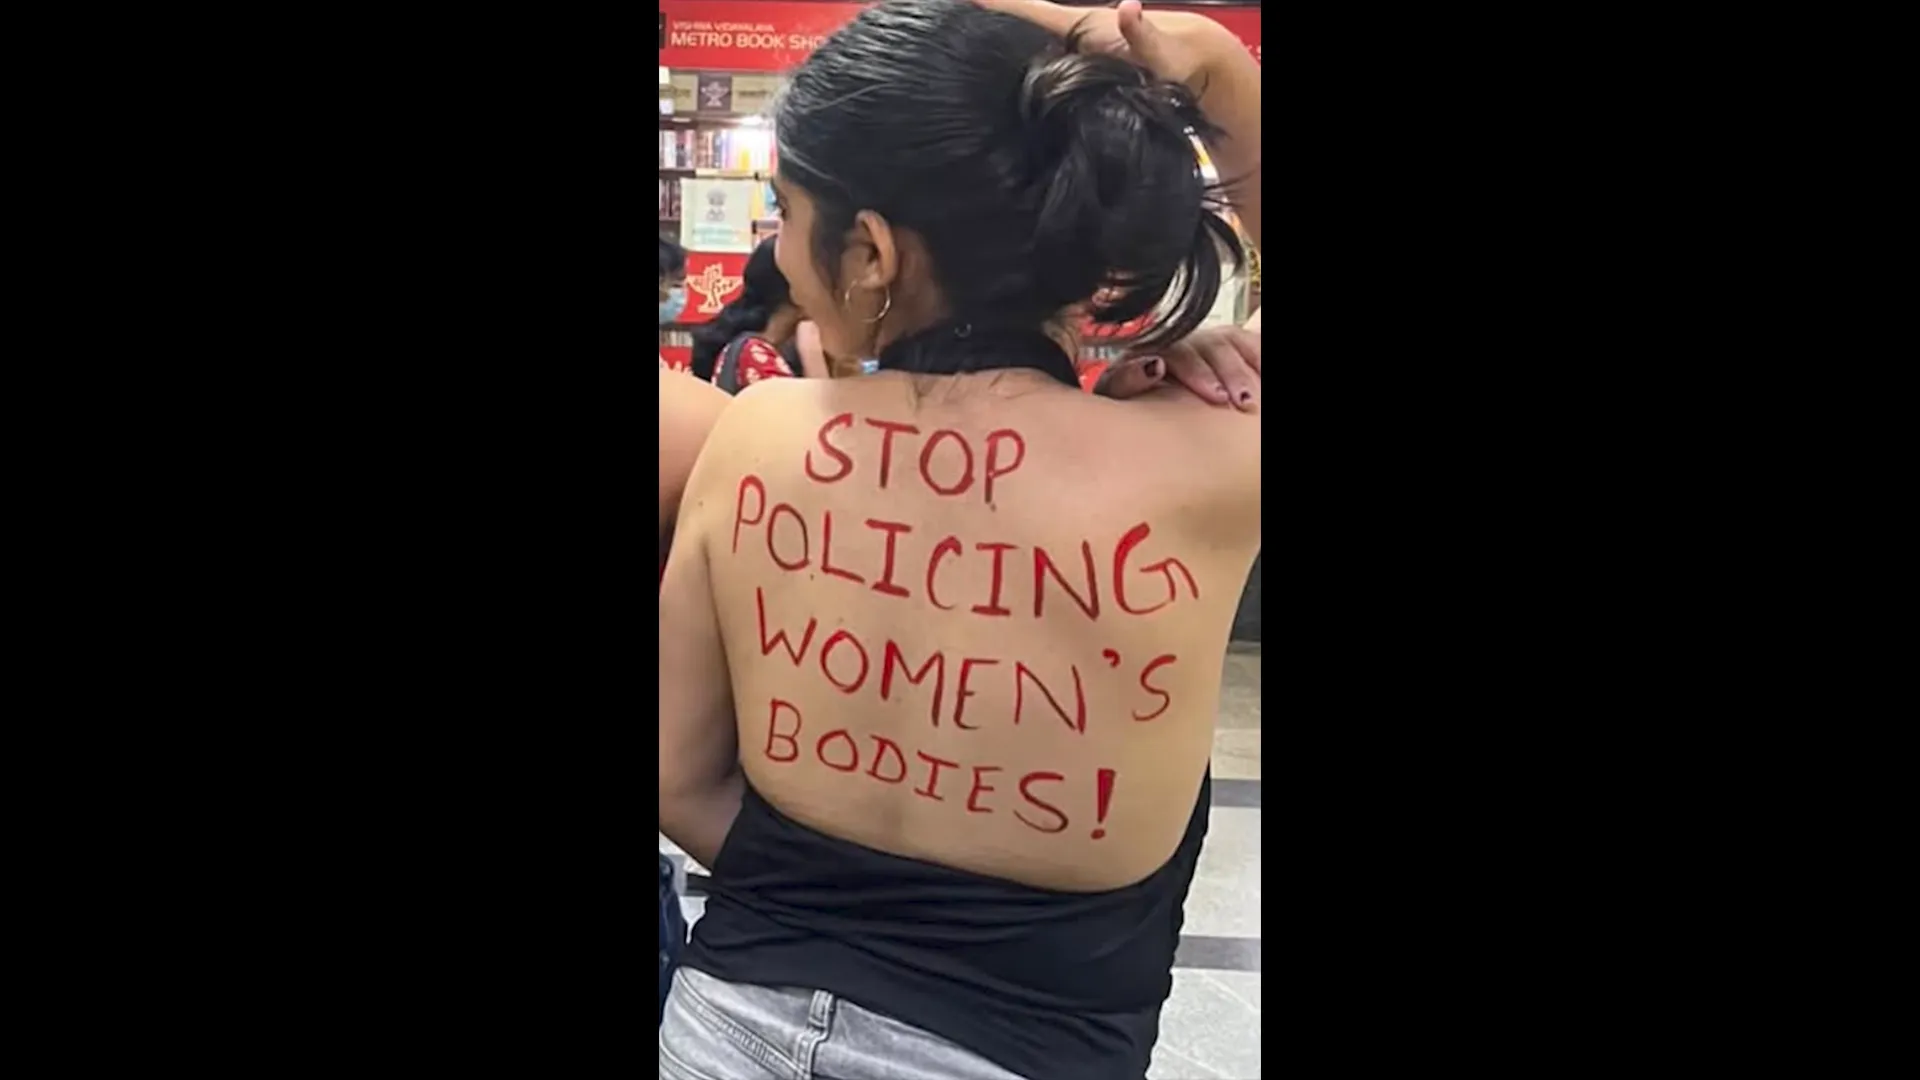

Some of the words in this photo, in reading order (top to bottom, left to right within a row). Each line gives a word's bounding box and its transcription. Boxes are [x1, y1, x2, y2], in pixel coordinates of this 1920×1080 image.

[671, 32, 732, 47] METRO
[736, 33, 785, 48] BOOK
[804, 412, 1026, 503] STOP
[732, 475, 1198, 621] POLICING
[756, 587, 1177, 734] WOMEN'S
[764, 698, 1116, 839] BODIES!
